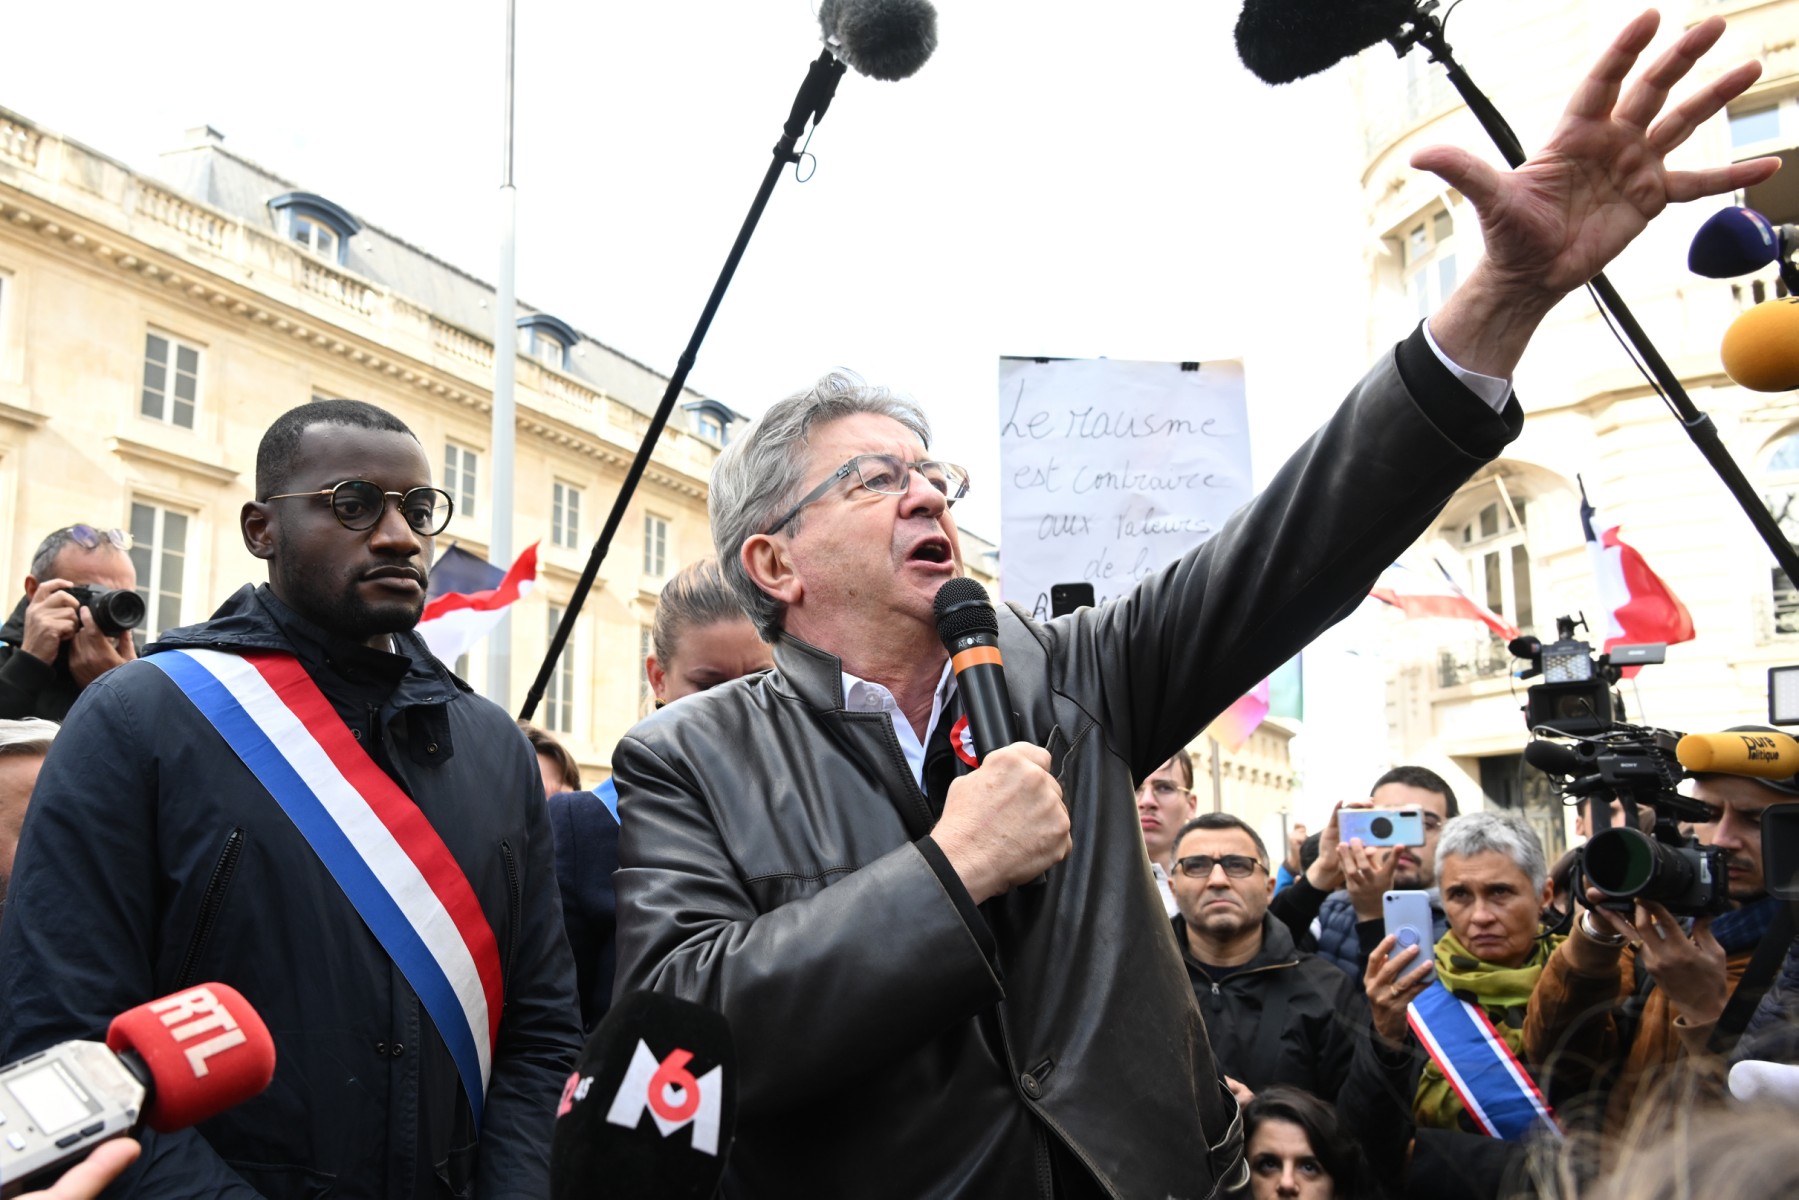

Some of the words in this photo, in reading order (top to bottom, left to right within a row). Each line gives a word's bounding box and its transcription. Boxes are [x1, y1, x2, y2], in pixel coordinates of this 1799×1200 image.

[1000, 378, 1055, 440] Le
[1013, 456, 1062, 493] est
[1037, 511, 1091, 541] aux
[1083, 546, 1115, 581] de
[149, 987, 247, 1079] RTL
